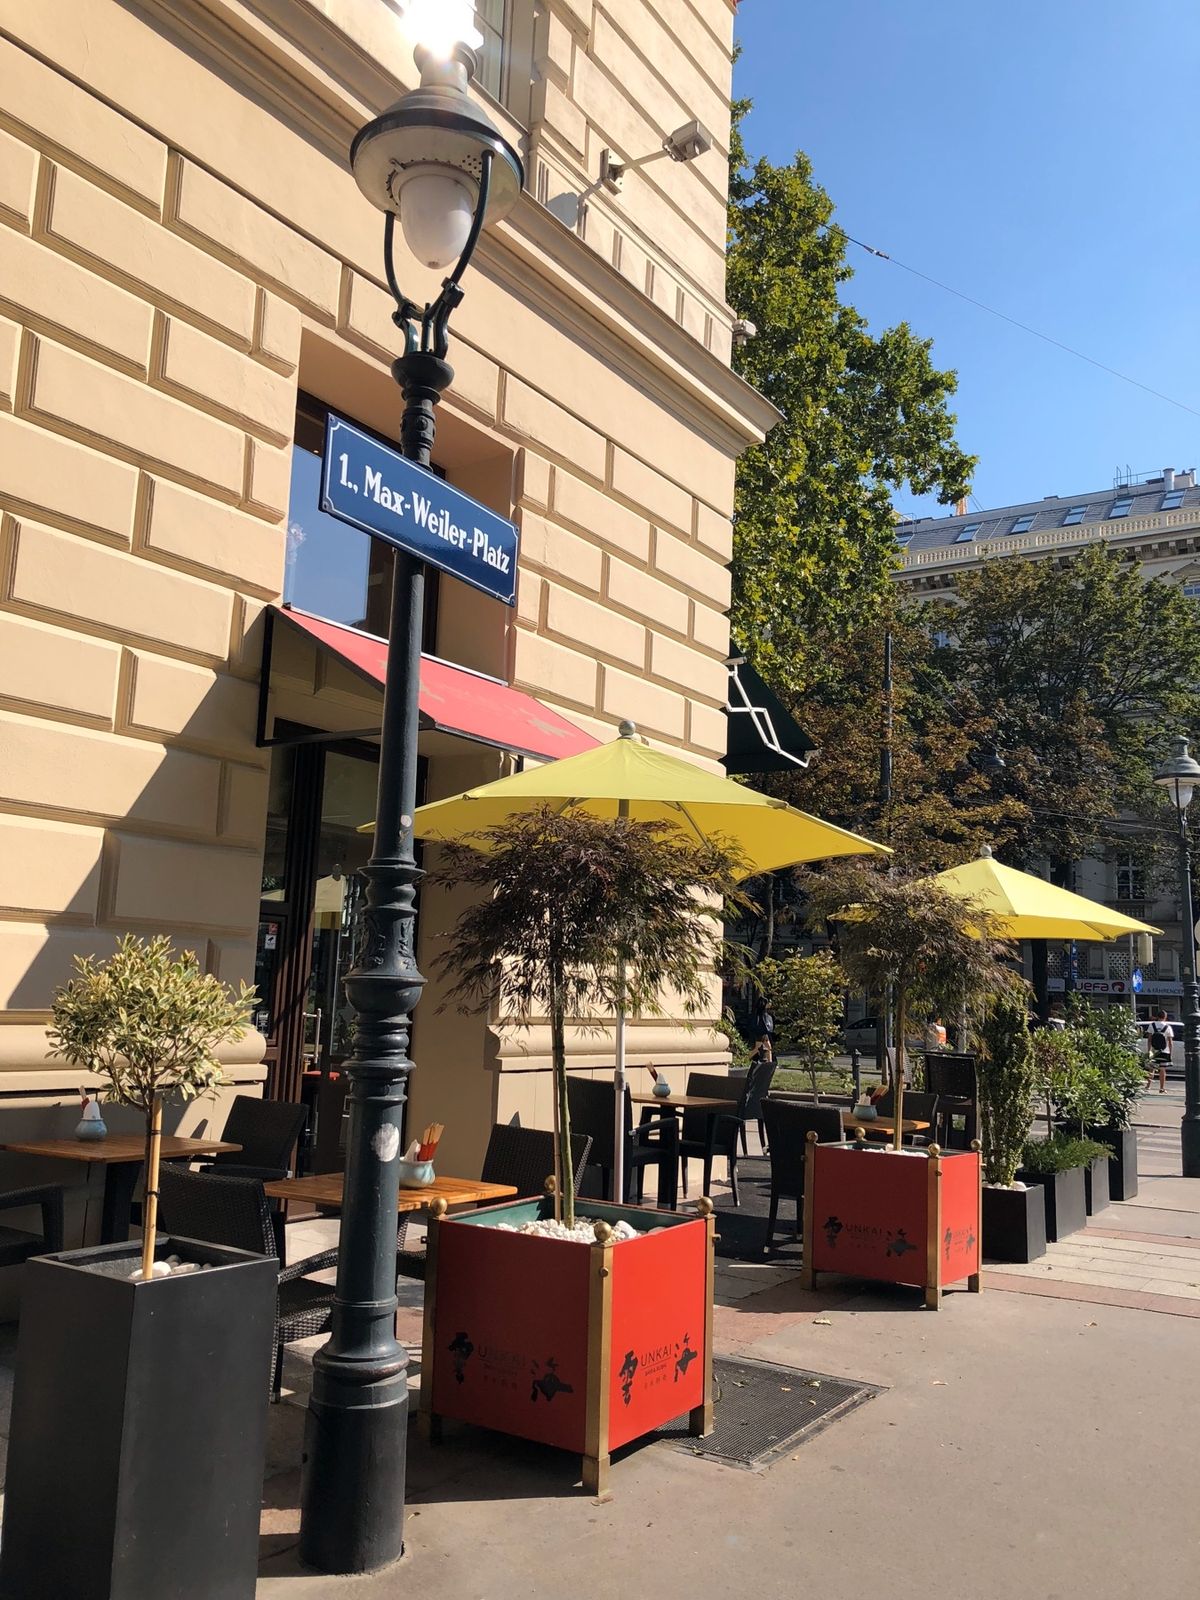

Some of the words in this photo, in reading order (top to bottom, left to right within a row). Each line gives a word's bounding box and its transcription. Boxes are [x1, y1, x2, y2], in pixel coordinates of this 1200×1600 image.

[339, 453, 359, 494] 1.,
[363, 464, 510, 575] Max-Weiler-Platz
[641, 1344, 672, 1367] UNKAI
